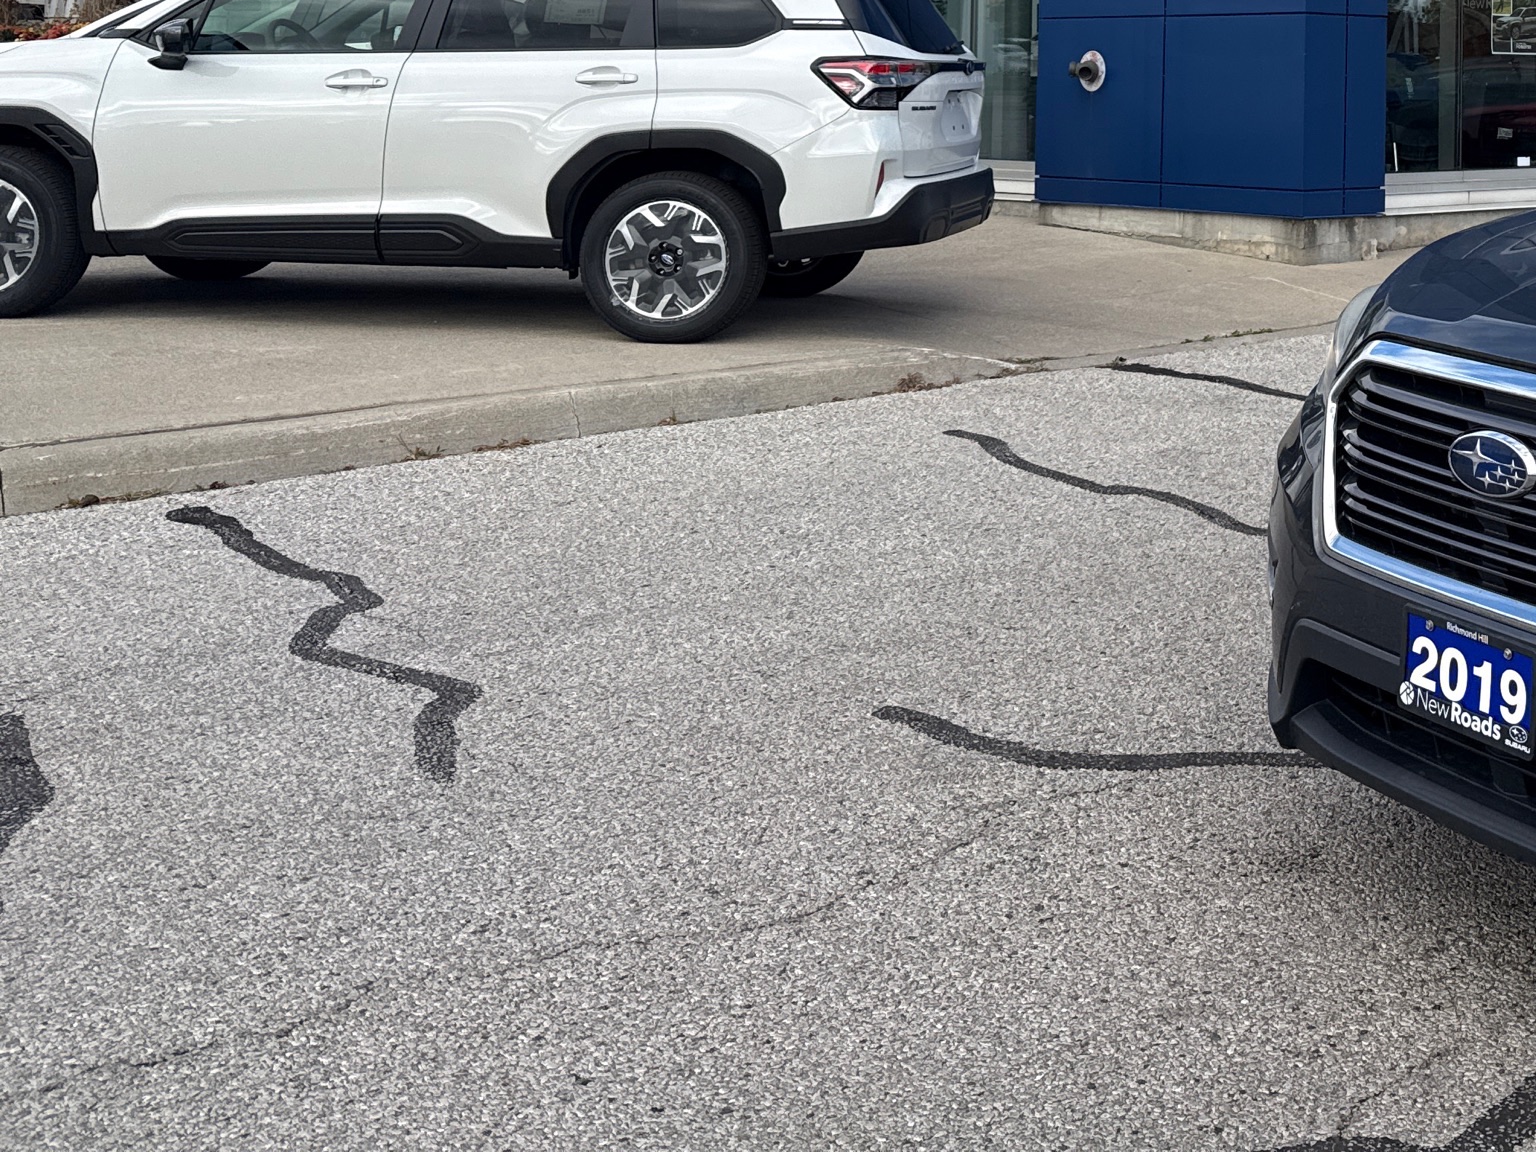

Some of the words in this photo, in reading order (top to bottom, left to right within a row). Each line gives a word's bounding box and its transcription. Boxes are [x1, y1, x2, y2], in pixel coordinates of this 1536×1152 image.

[1446, 621, 1477, 641] Richmond
[1477, 633, 1489, 645] Hill
[1409, 636, 1527, 725] 2019
[1416, 688, 1501, 741] NewRoads
[1504, 738, 1531, 754] SUBARU
